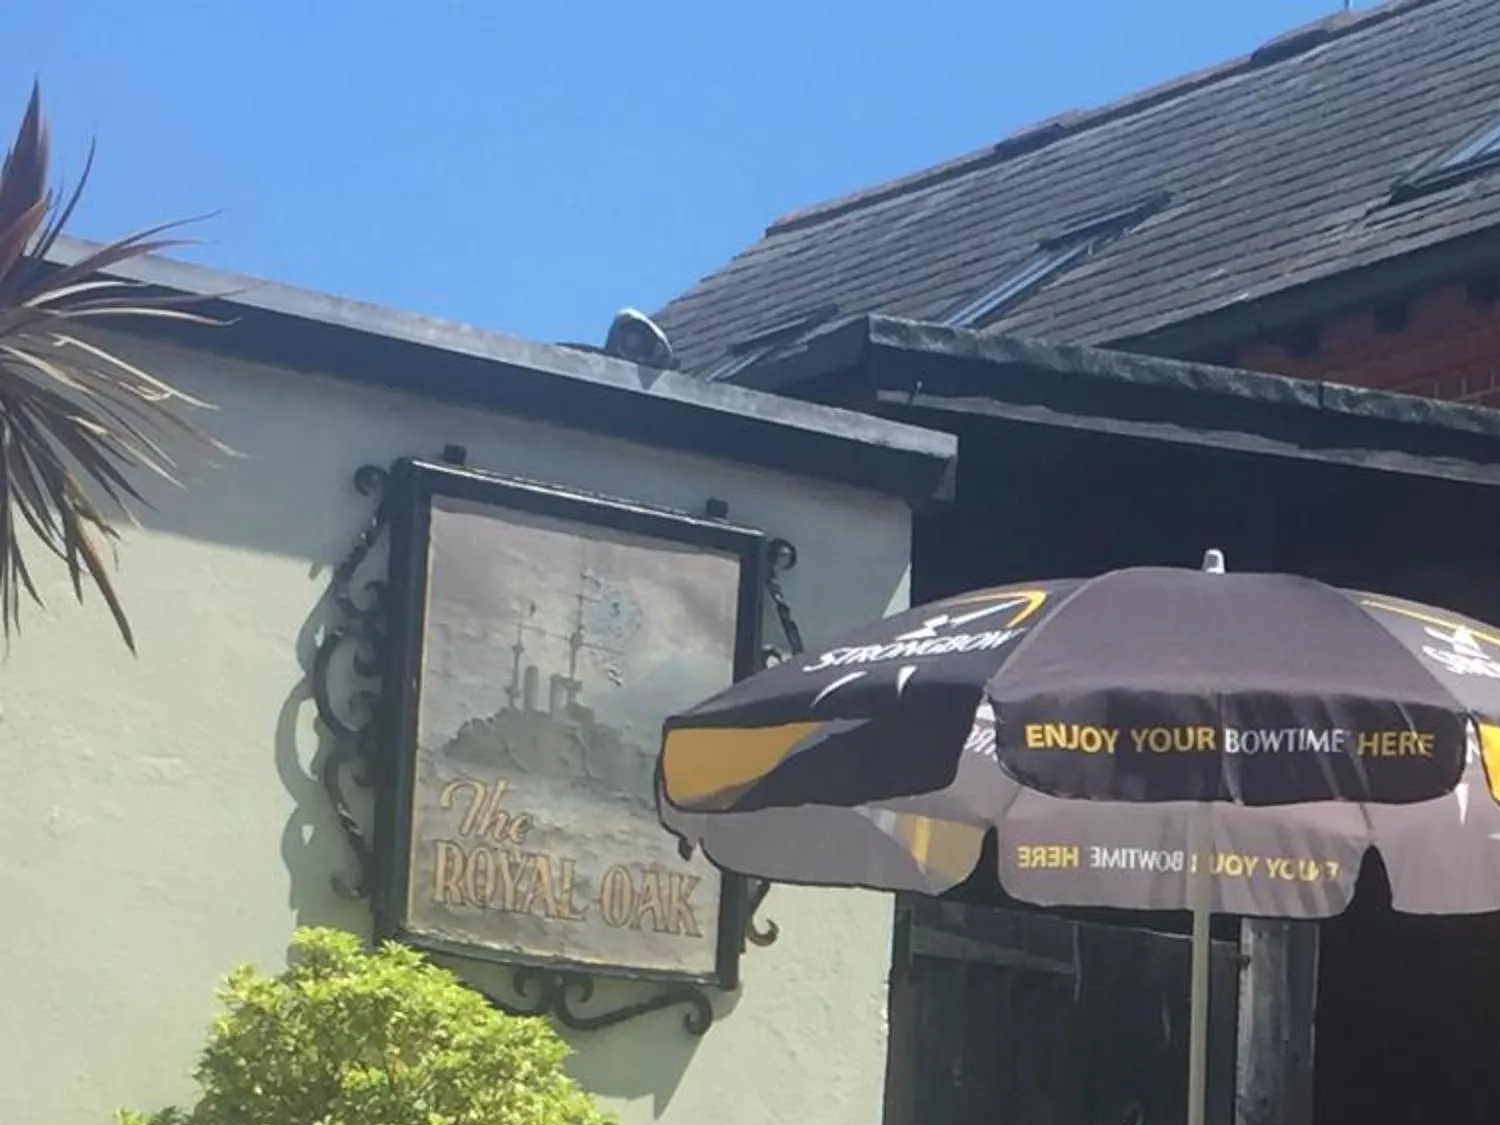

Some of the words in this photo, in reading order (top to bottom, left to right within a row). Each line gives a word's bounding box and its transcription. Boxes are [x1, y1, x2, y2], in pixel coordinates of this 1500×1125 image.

[1026, 723, 1120, 754] ENJOY
[1131, 727, 1216, 753] YOUR
[1225, 728, 1346, 755] BOWTIME
[1357, 732, 1434, 757] HERE
[441, 778, 534, 845] The
[432, 839, 590, 922] ROYAL
[600, 864, 704, 938] OAK
